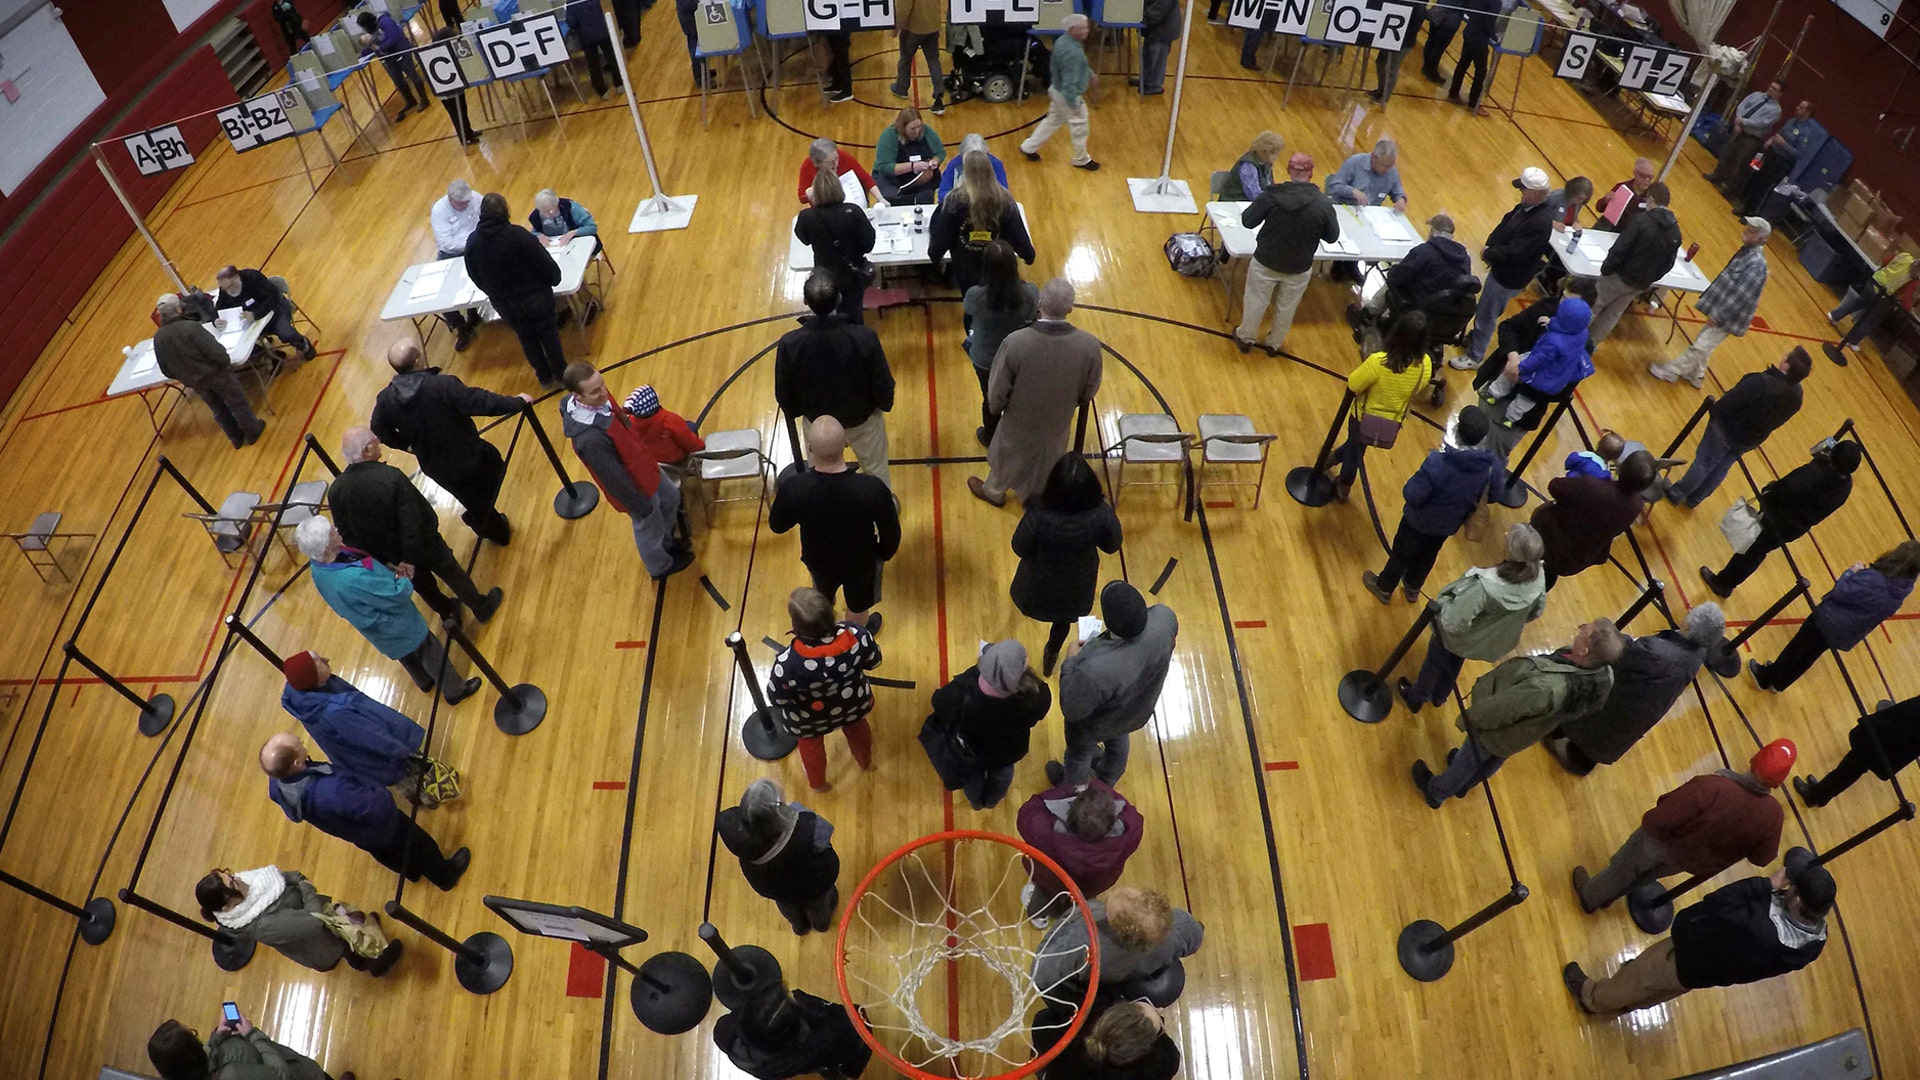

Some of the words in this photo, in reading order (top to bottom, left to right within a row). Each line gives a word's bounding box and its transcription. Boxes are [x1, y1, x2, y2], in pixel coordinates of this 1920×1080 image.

[1333, 6, 1405, 41] O-R
[488, 26, 555, 68] D-F
[1566, 45, 1588, 69] S
[429, 56, 457, 85] C
[1633, 55, 1683, 87] T-Z
[221, 107, 287, 141] Bi-Bz
[135, 137, 190, 167] A-Bh
